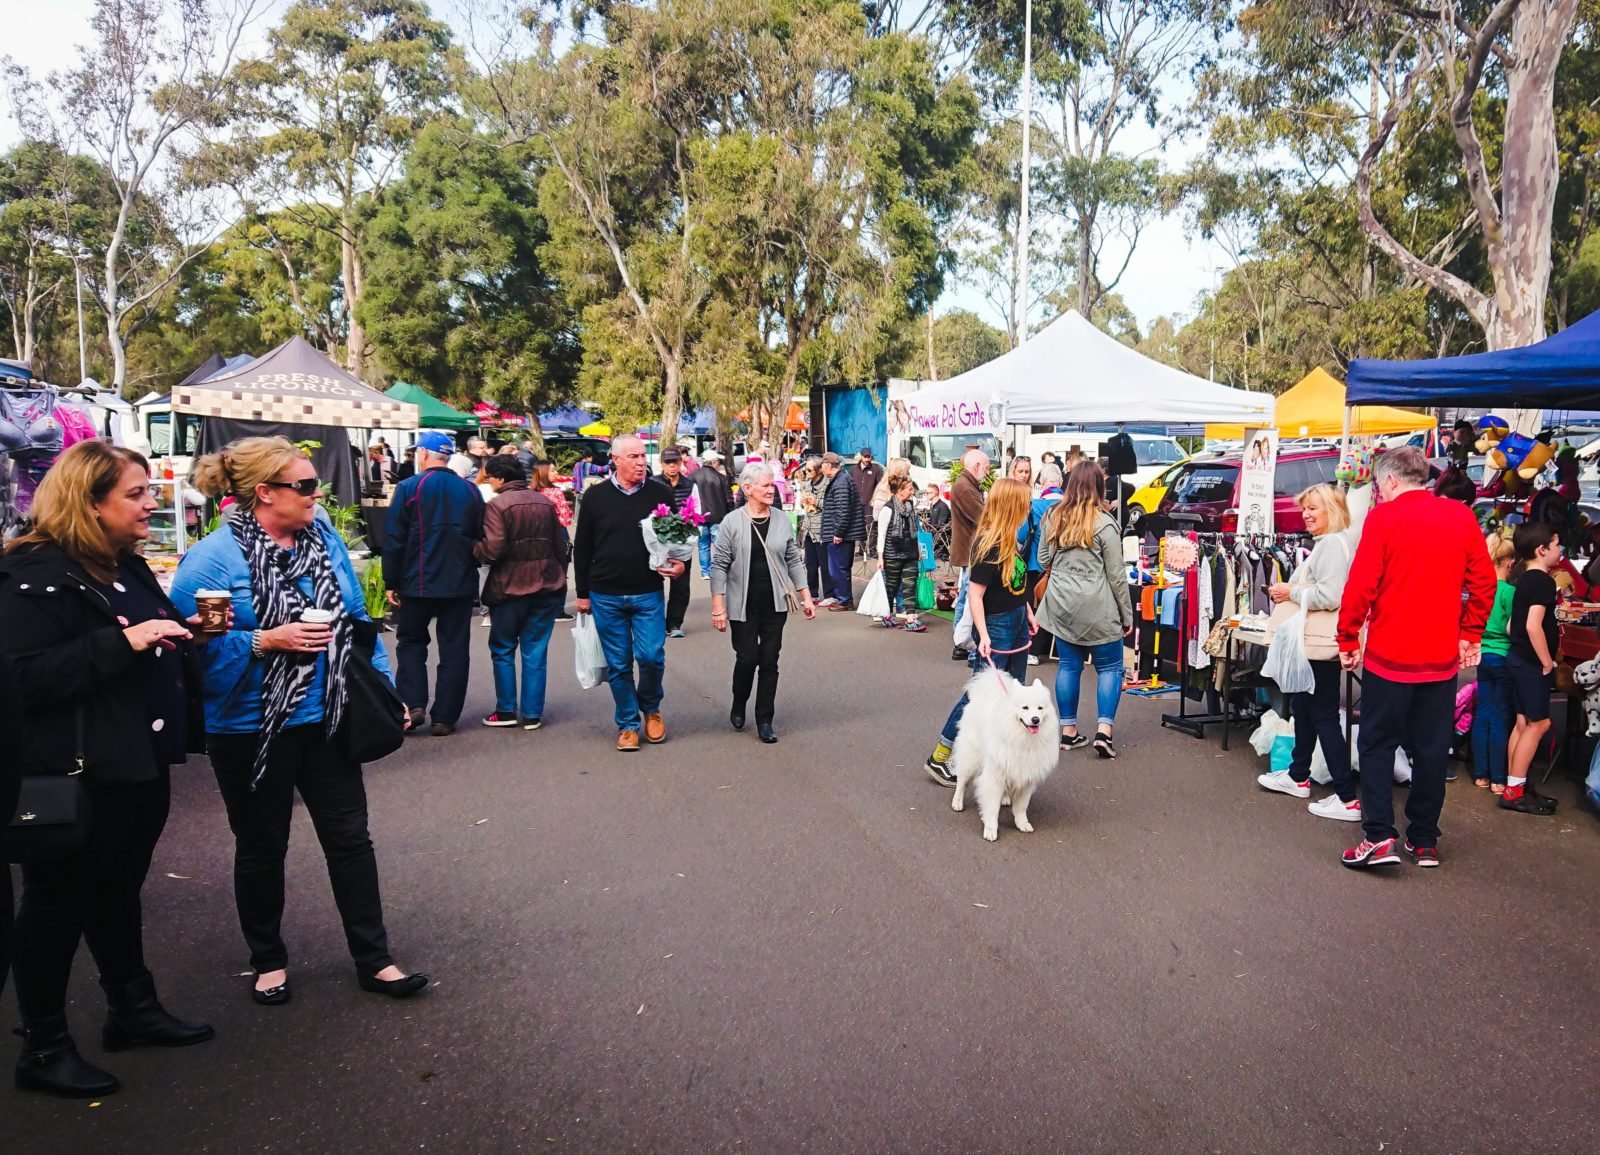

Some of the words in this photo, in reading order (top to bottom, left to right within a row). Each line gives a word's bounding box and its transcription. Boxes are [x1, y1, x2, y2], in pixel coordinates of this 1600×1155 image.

[257, 373, 341, 387] FRESH
[234, 382, 363, 397] LICORICE
[910, 406, 940, 428] Flower
[942, 404, 957, 428] Pot
[959, 401, 985, 427] Girls
